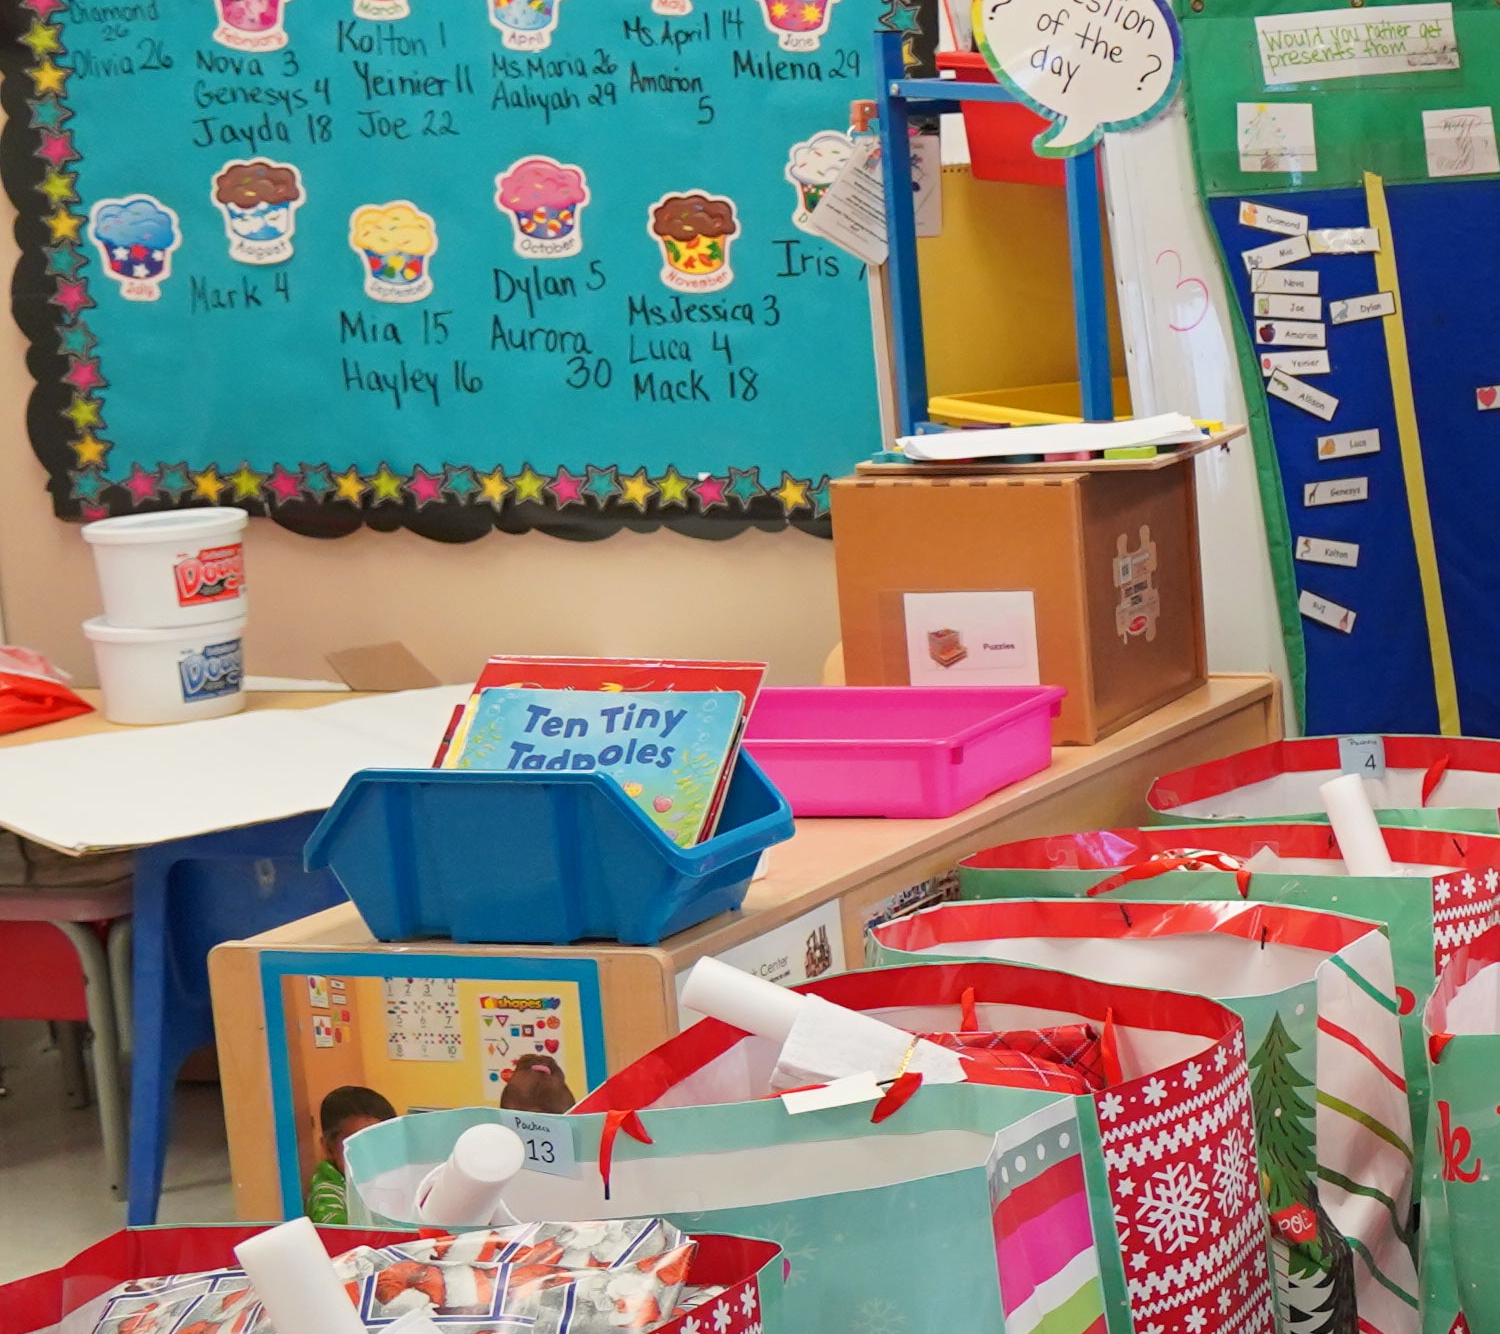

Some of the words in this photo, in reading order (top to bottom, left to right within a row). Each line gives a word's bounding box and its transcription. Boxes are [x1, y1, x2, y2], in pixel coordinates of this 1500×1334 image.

[360, 1, 404, 16] March
[219, 28, 283, 48] February
[337, 19, 429, 57] Kolton
[507, 30, 546, 46] April
[721, 8, 745, 41] 14
[1036, 9, 1069, 39] of
[1076, 21, 1124, 65] the
[1261, 27, 1323, 52] Would
[1330, 25, 1359, 48] you
[1365, 20, 1411, 41] rather
[138, 38, 174, 70] 26
[784, 34, 815, 48] June
[196, 51, 264, 78] Nova
[282, 50, 300, 77] 3
[591, 48, 618, 77] 26
[732, 50, 824, 83] Milena
[827, 49, 861, 79] 29
[1031, 47, 1081, 94] day
[1267, 48, 1357, 76] presents
[1364, 41, 1407, 56] from
[194, 79, 309, 113] Genesys
[314, 77, 332, 106] 4
[587, 83, 618, 107] 29
[697, 95, 716, 126] 5
[191, 112, 290, 154] Jayda
[308, 113, 333, 145] 18
[357, 109, 412, 140] Joe
[423, 110, 461, 136] 22
[237, 241, 287, 260] August
[519, 238, 576, 255] October
[771, 239, 841, 278] Iris
[126, 282, 154, 298] July
[189, 276, 262, 315] Mark
[274, 272, 291, 303] 4
[492, 265, 577, 318] Dylan
[588, 260, 607, 291] 5
[667, 269, 730, 288] November
[764, 294, 781, 326] 3
[1290, 303, 1305, 314] Joe
[1359, 301, 1383, 315] Dylan
[340, 309, 404, 345] Mia
[423, 310, 454, 346] 15
[491, 314, 593, 355] Aurora
[629, 334, 691, 365] Luca
[712, 334, 733, 365] 4
[343, 357, 440, 410] Hayley
[455, 358, 485, 394] 16
[566, 357, 613, 389] 30
[633, 372, 710, 403] Mack
[729, 367, 760, 402] 18
[525, 704, 590, 739] Ten
[601, 702, 688, 739] Tiny
[1365, 754, 1377, 770] 4
[760, 956, 789, 977] Center
[499, 997, 542, 1012] shapes
[526, 1139, 555, 1164] 13
